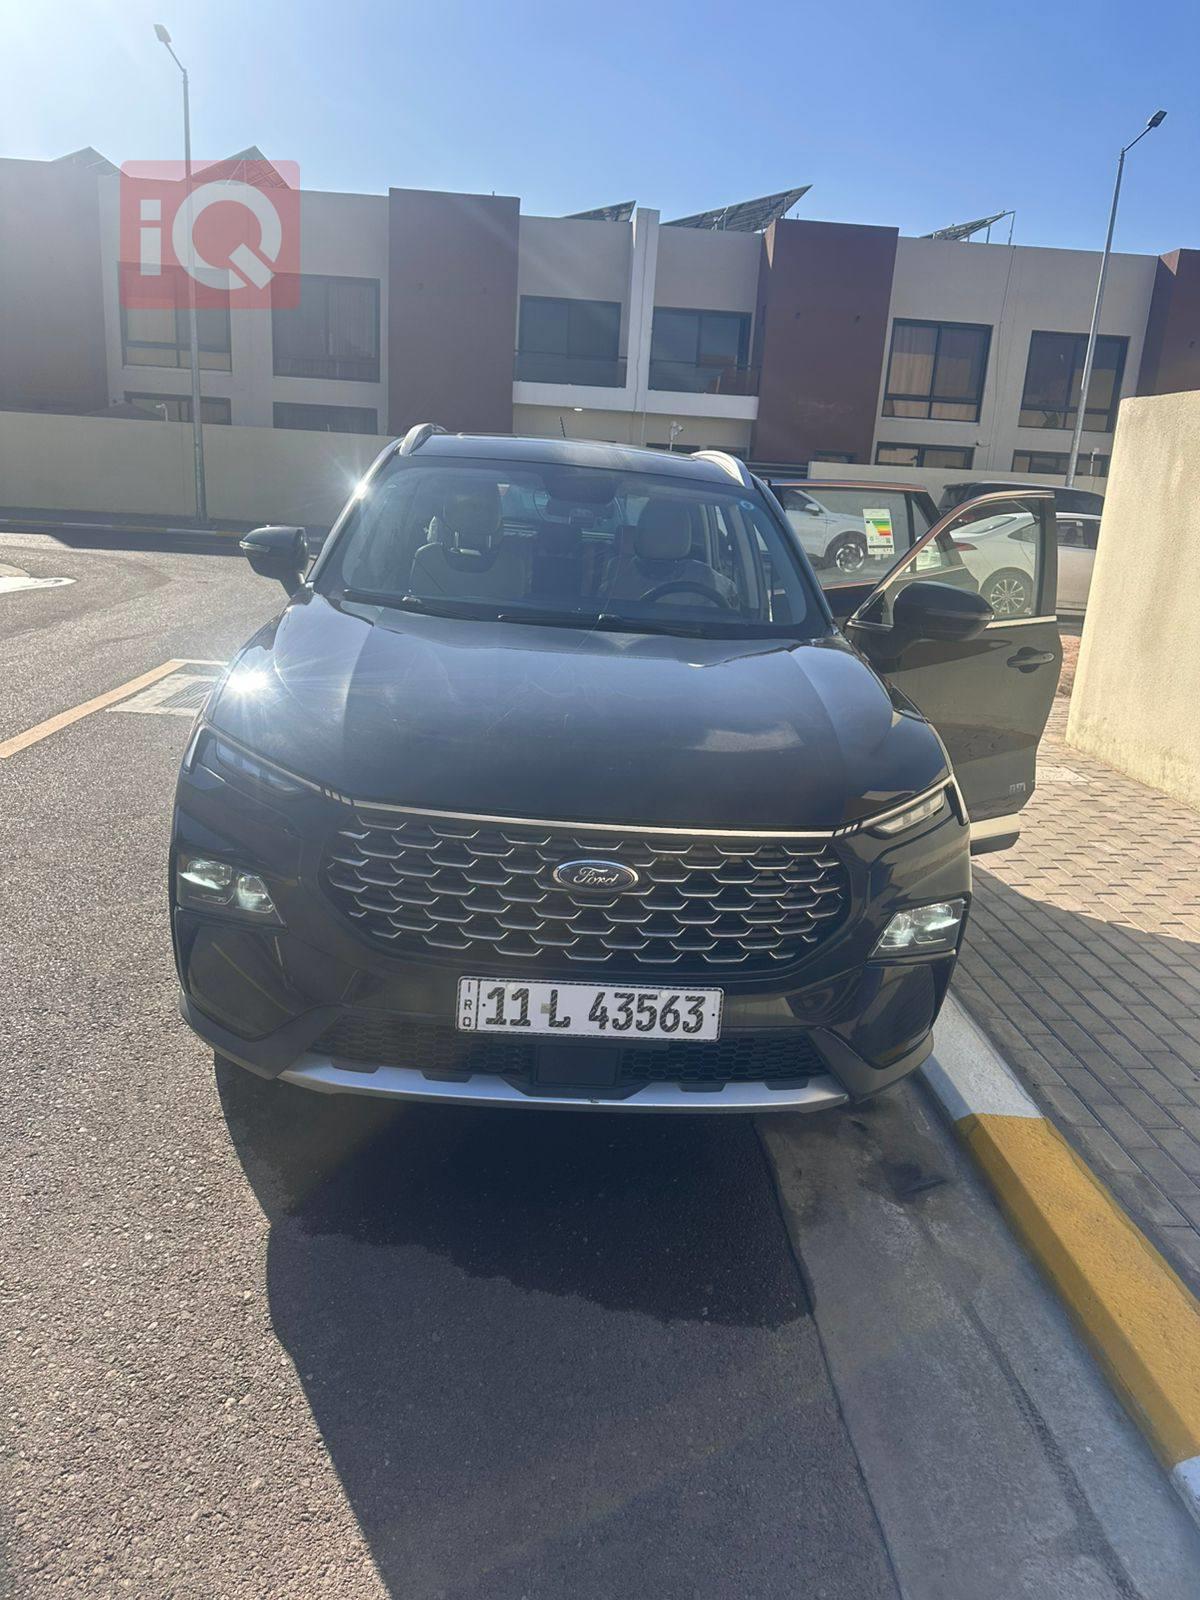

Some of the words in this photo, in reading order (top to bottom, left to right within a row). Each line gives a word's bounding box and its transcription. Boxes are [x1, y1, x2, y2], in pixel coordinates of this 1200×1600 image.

[573, 866, 619, 885] Ford
[462, 981, 474, 1028] IRQ
[485, 986, 531, 1027] 11
[548, 989, 571, 1028] L
[588, 991, 706, 1033] 43563
